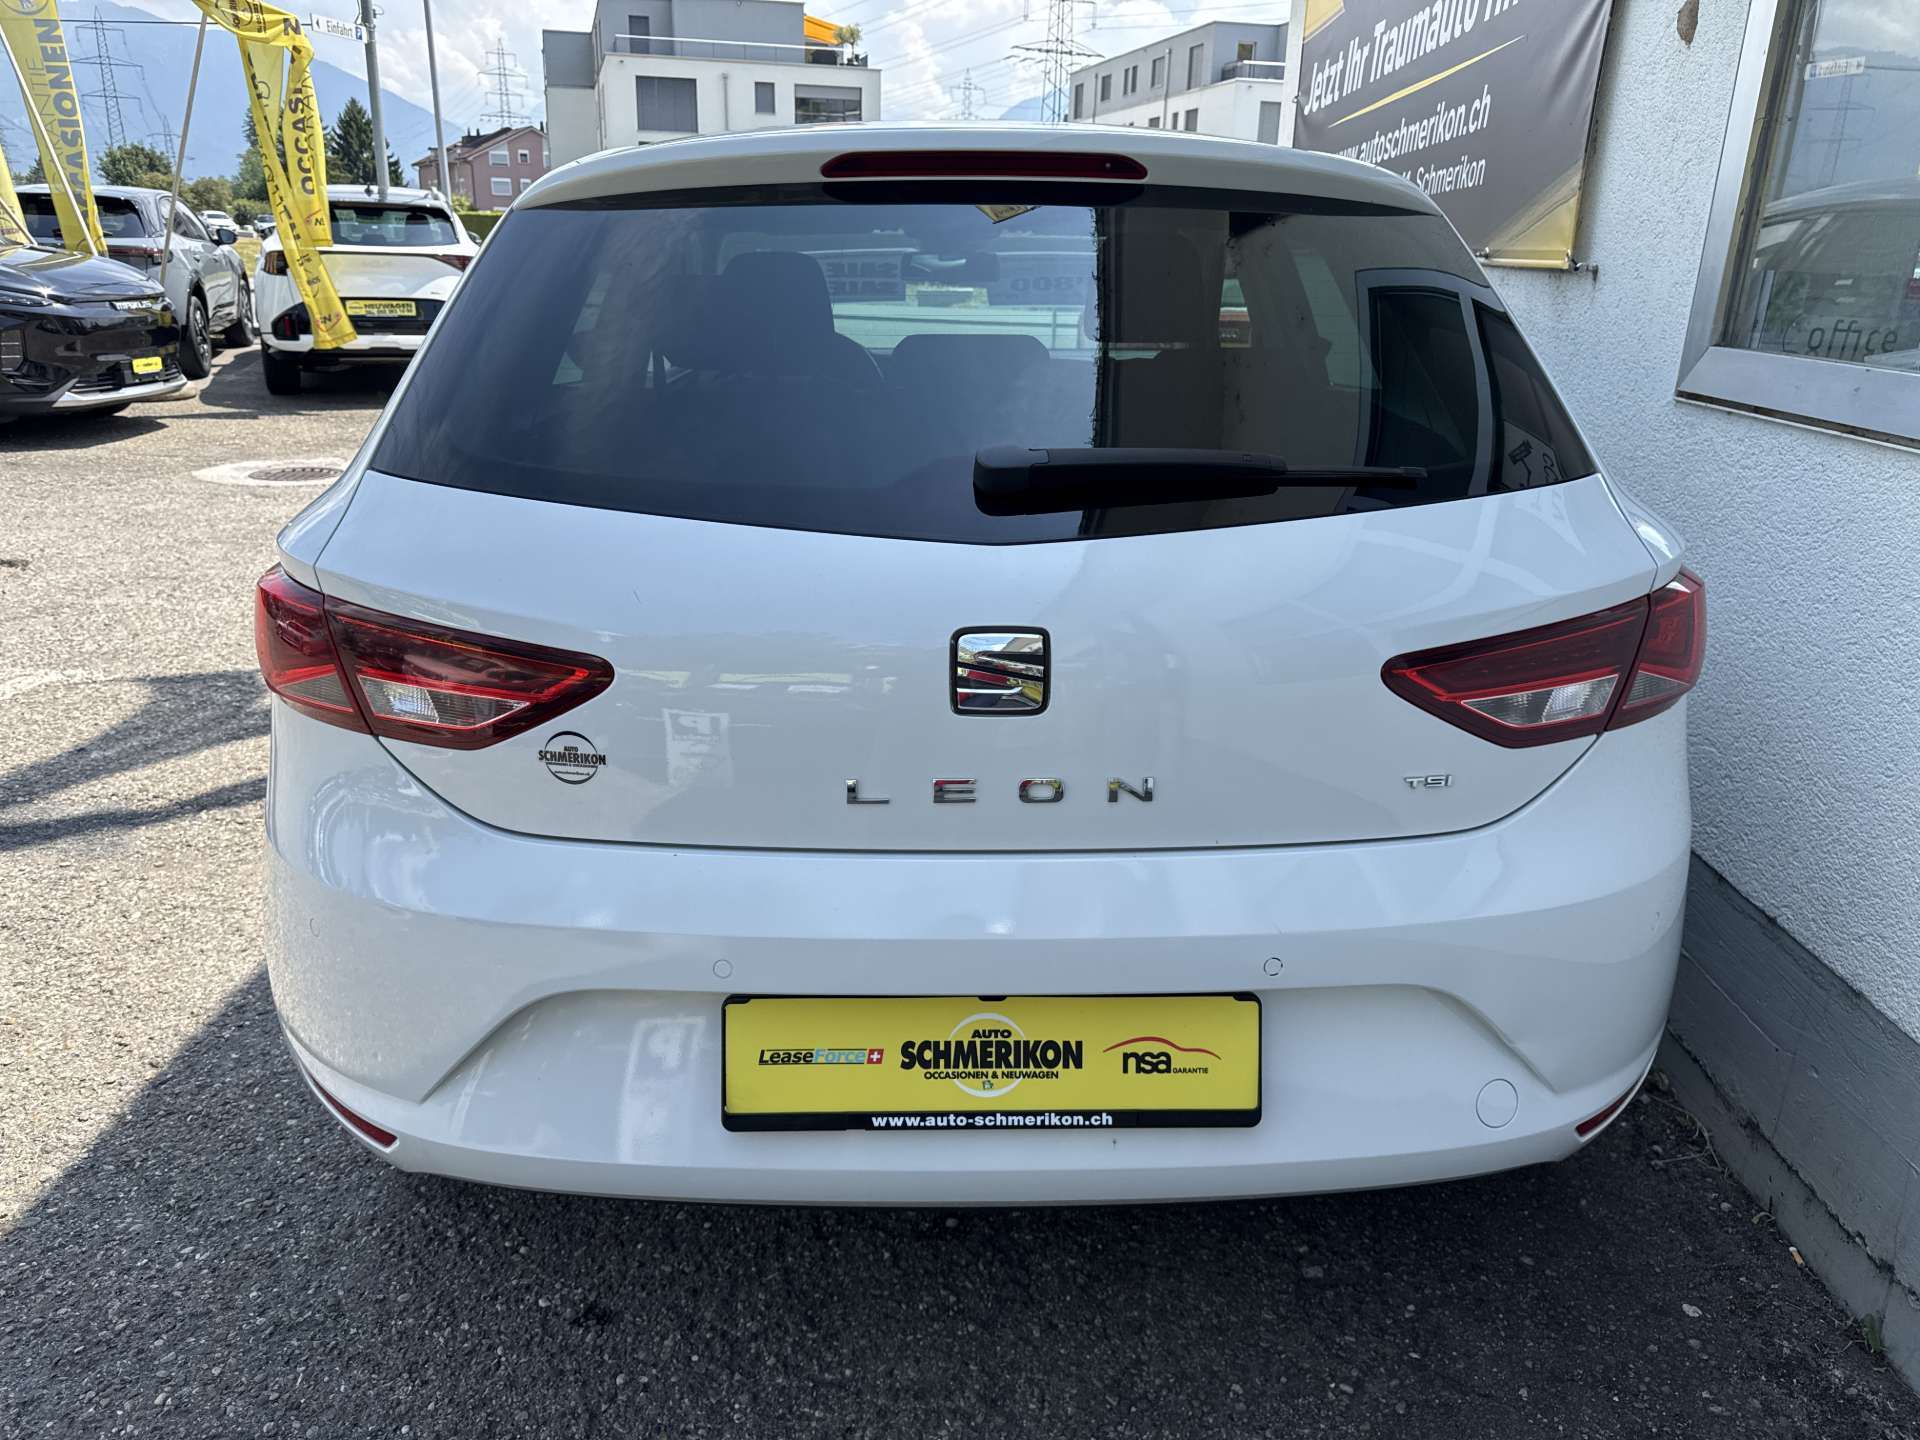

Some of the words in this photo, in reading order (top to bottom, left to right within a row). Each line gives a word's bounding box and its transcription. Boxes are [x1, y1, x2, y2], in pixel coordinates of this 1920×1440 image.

[326, 22, 354, 39] Einfahrt
[1304, 51, 1345, 116] Jetzt
[1342, 37, 1371, 97] Ihr
[1370, 0, 1477, 83] Traumauto
[1416, 156, 1486, 195] Schmerikon
[538, 750, 607, 765] SCHMERIKON
[1403, 773, 1453, 790] TSI
[846, 776, 1153, 805] LEON
[971, 1029, 1012, 1039] AUTO
[759, 1049, 867, 1064] LeaseForce
[900, 1040, 1083, 1070] SCHMERIKON
[1122, 1051, 1172, 1074] nsa
[924, 1070, 989, 1080] OCCASIONEN
[991, 1070, 999, 1080] &
[1001, 1070, 1059, 1080] NEUWAGEN
[872, 1112, 1113, 1127] www.auto-schmerikon.ch
